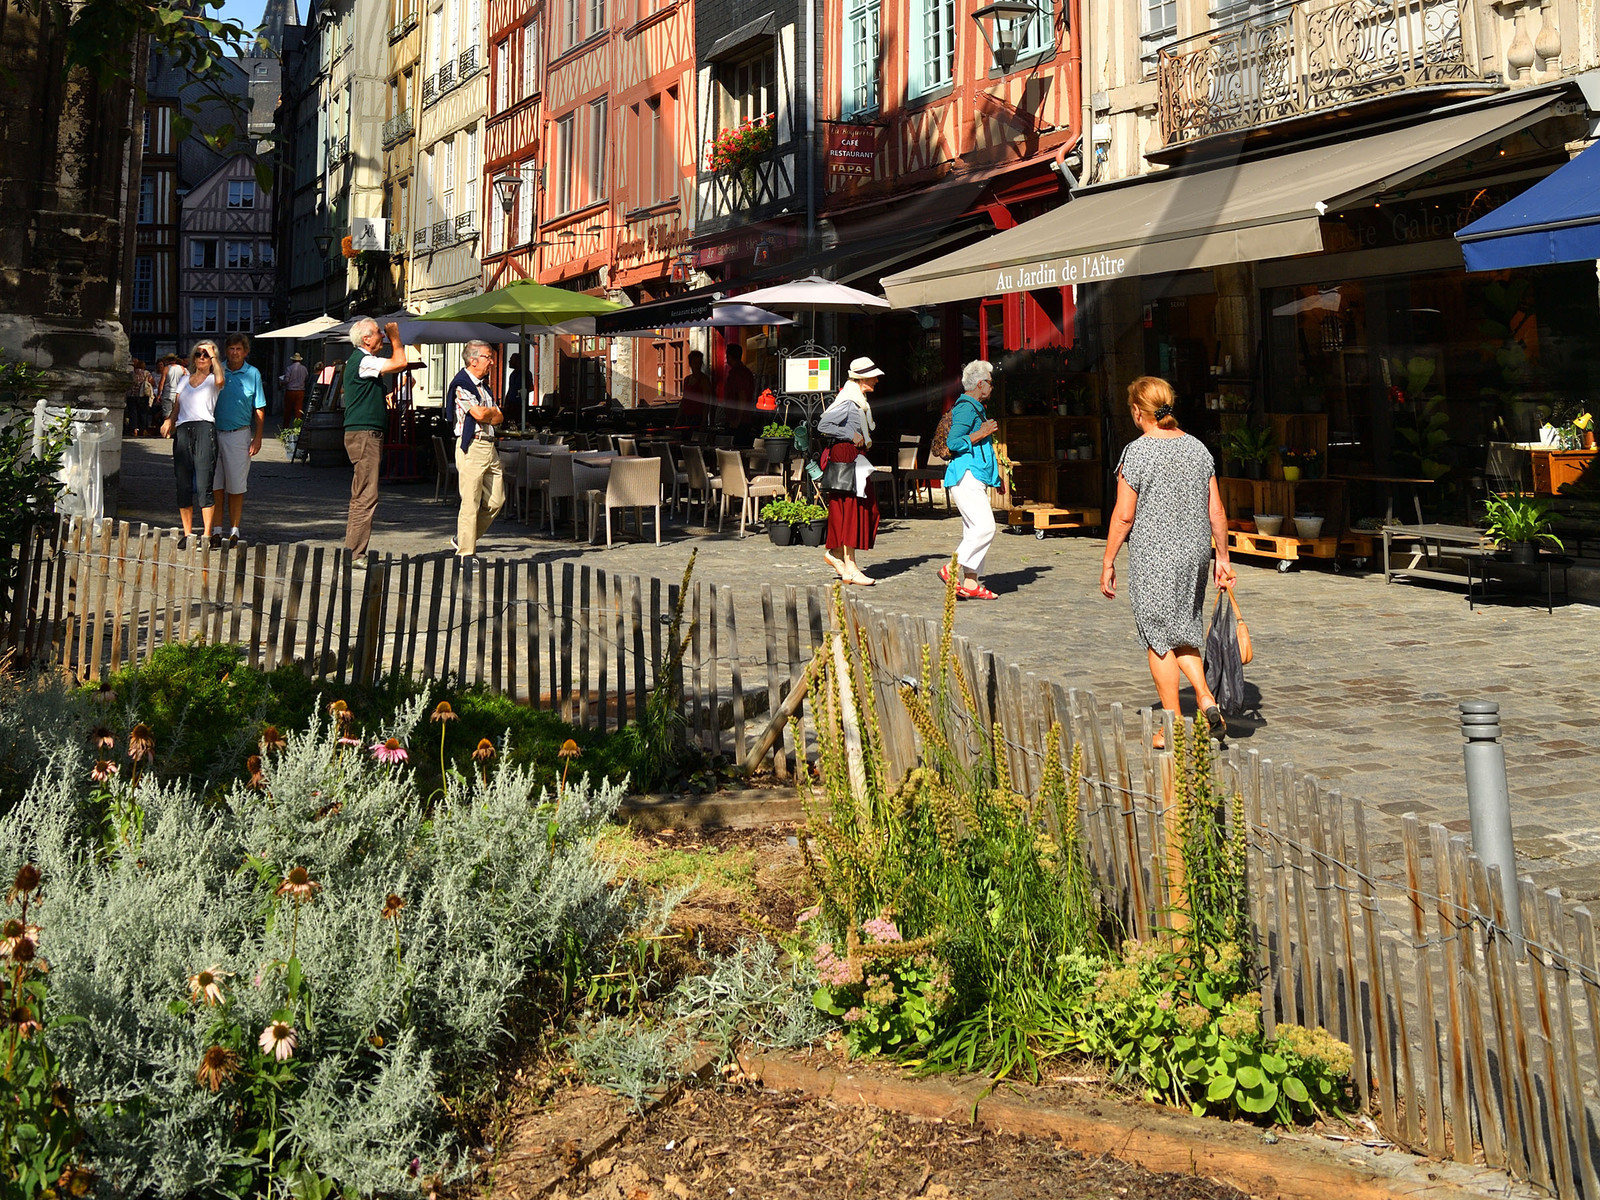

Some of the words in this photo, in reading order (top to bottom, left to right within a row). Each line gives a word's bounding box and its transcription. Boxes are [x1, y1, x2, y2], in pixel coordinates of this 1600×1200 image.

[830, 149, 874, 158] RESTAURANT
[831, 164, 872, 174] TAPAS
[996, 271, 1013, 291] Au
[1017, 264, 1056, 288] Jardin
[1061, 260, 1078, 282] de
[1082, 254, 1125, 279] l'Aître
